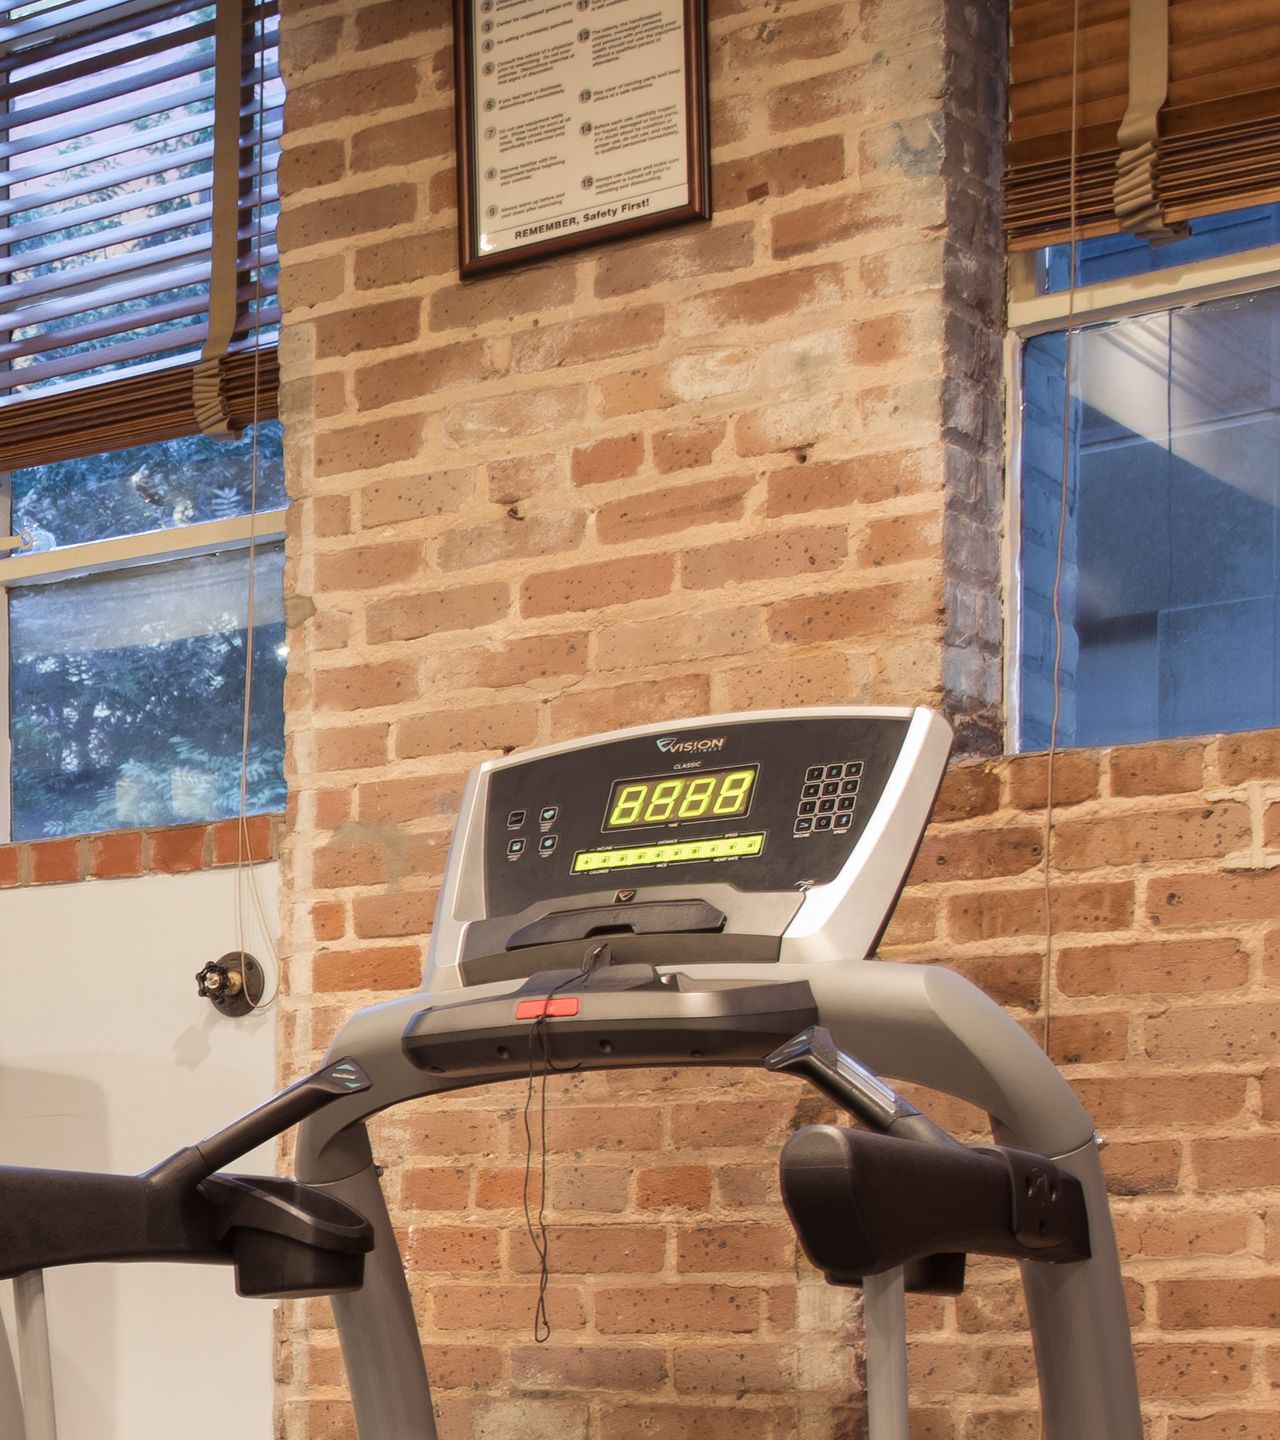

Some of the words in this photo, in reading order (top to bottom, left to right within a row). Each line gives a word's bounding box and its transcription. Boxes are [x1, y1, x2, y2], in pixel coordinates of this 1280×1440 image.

[514, 217, 580, 240] REMEMBER,
[583, 208, 618, 223] Safety
[621, 198, 650, 213] First!
[670, 738, 724, 753] VISION
[673, 761, 702, 770] CLASSIC
[609, 770, 756, 825] 8888
